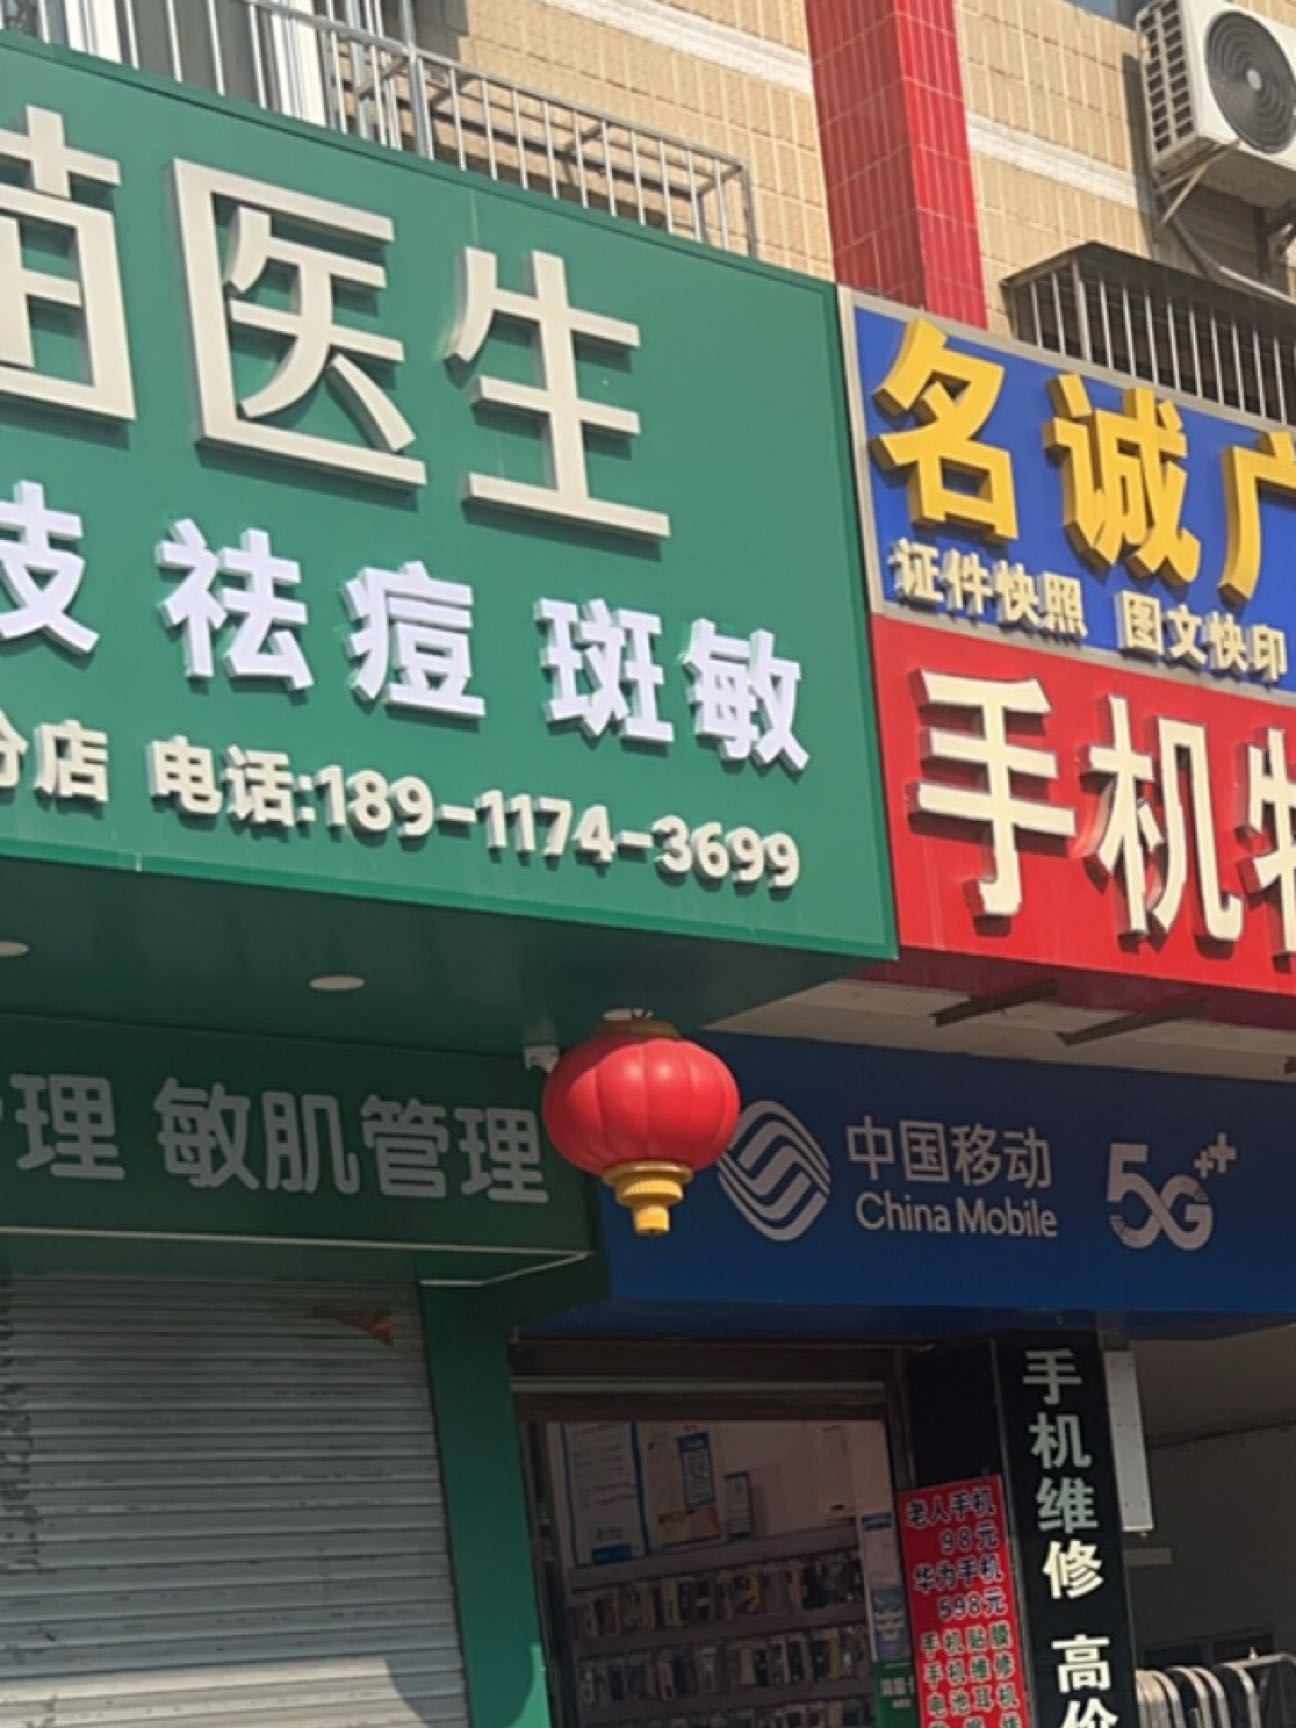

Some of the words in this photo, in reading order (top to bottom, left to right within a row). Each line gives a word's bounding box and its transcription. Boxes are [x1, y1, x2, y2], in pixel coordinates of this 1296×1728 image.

[888, 538, 1088, 640] 证件快照
[1115, 589, 1289, 683] 图文快印
[154, 1077, 549, 1204] 敏肌管理
[845, 1114, 1053, 1190] 中国移动
[855, 1189, 952, 1233] China
[955, 1196, 1059, 1239] Mobile
[1023, 1347, 1104, 1601] 手机维修
[906, 1484, 998, 1529] 老人手机
[940, 1522, 1000, 1555] 98元
[912, 1552, 1003, 1595] 华为手机
